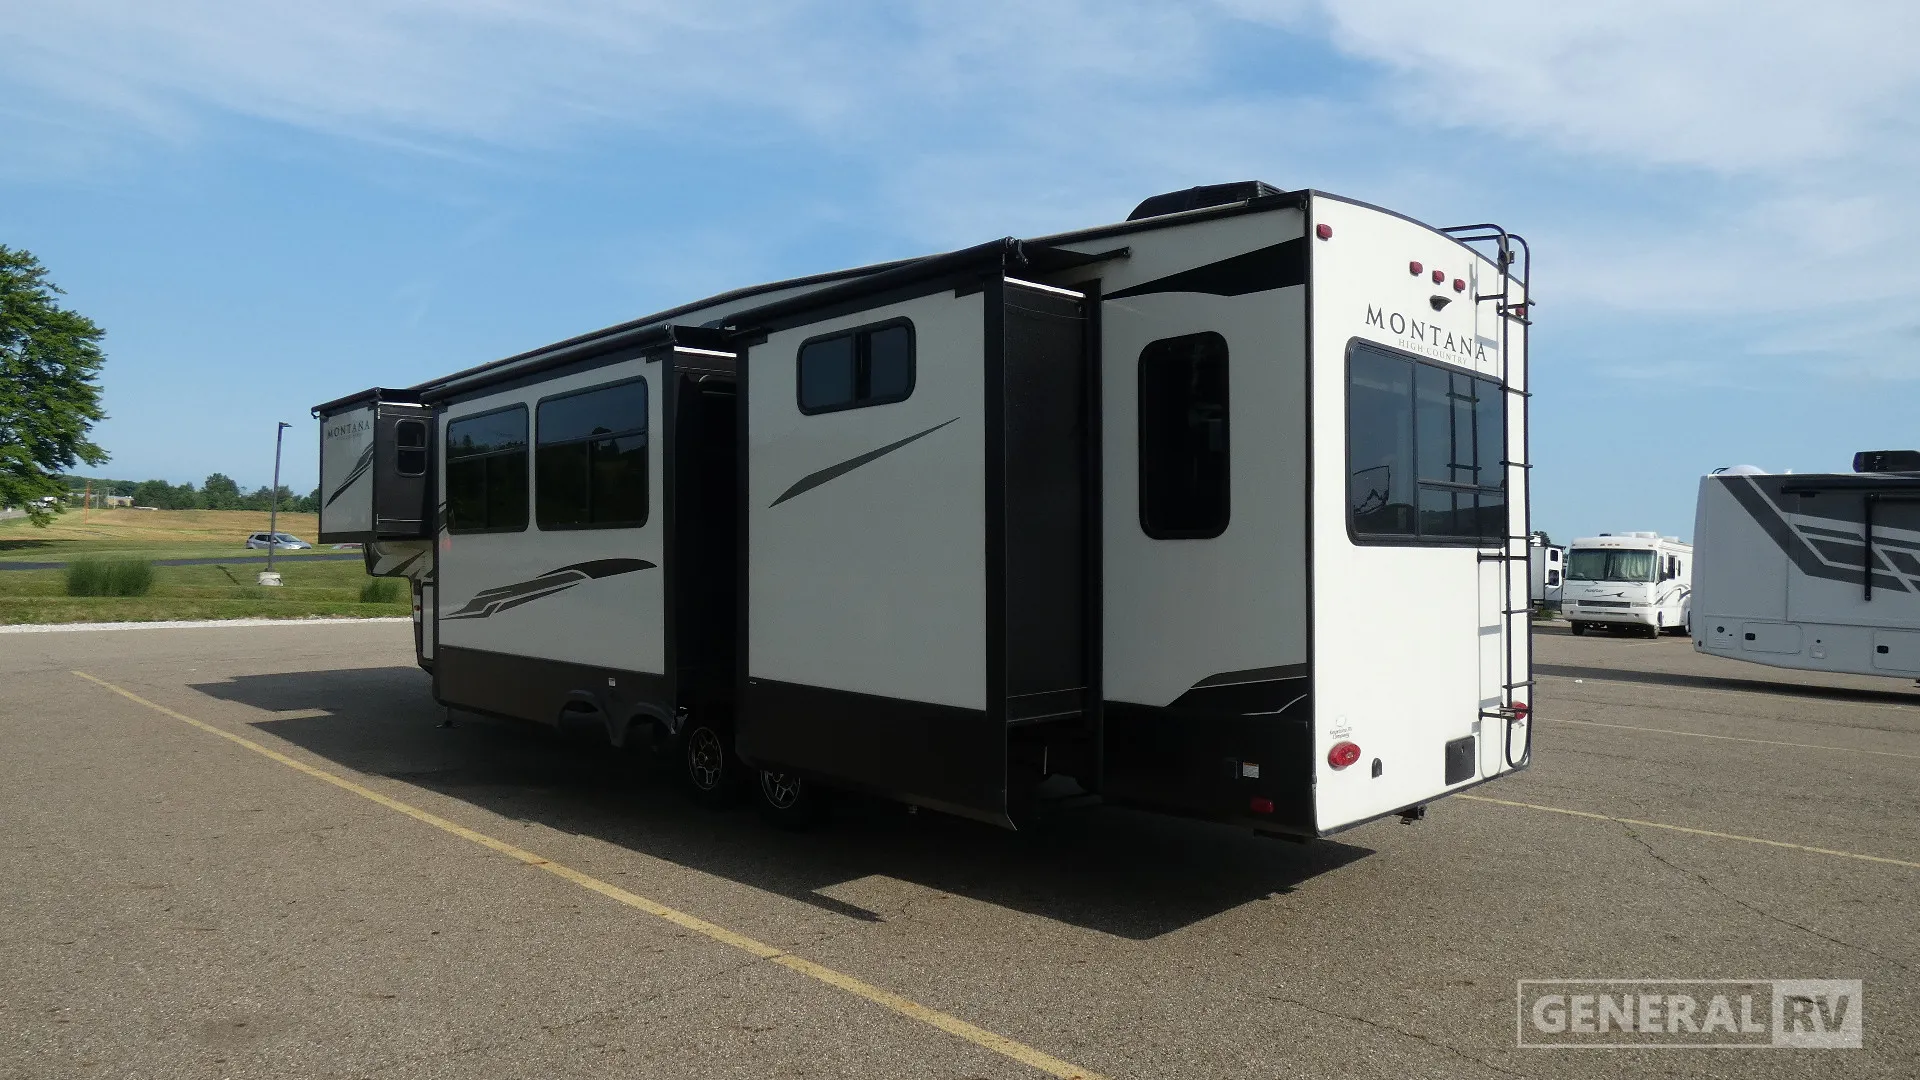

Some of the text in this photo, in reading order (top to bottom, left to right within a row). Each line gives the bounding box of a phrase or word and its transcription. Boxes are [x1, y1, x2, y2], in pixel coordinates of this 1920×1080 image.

[1365, 303, 1487, 362] MONTANA
[1398, 338, 1467, 366] HIGH COUNTRY
[327, 420, 370, 438] MONTANA
